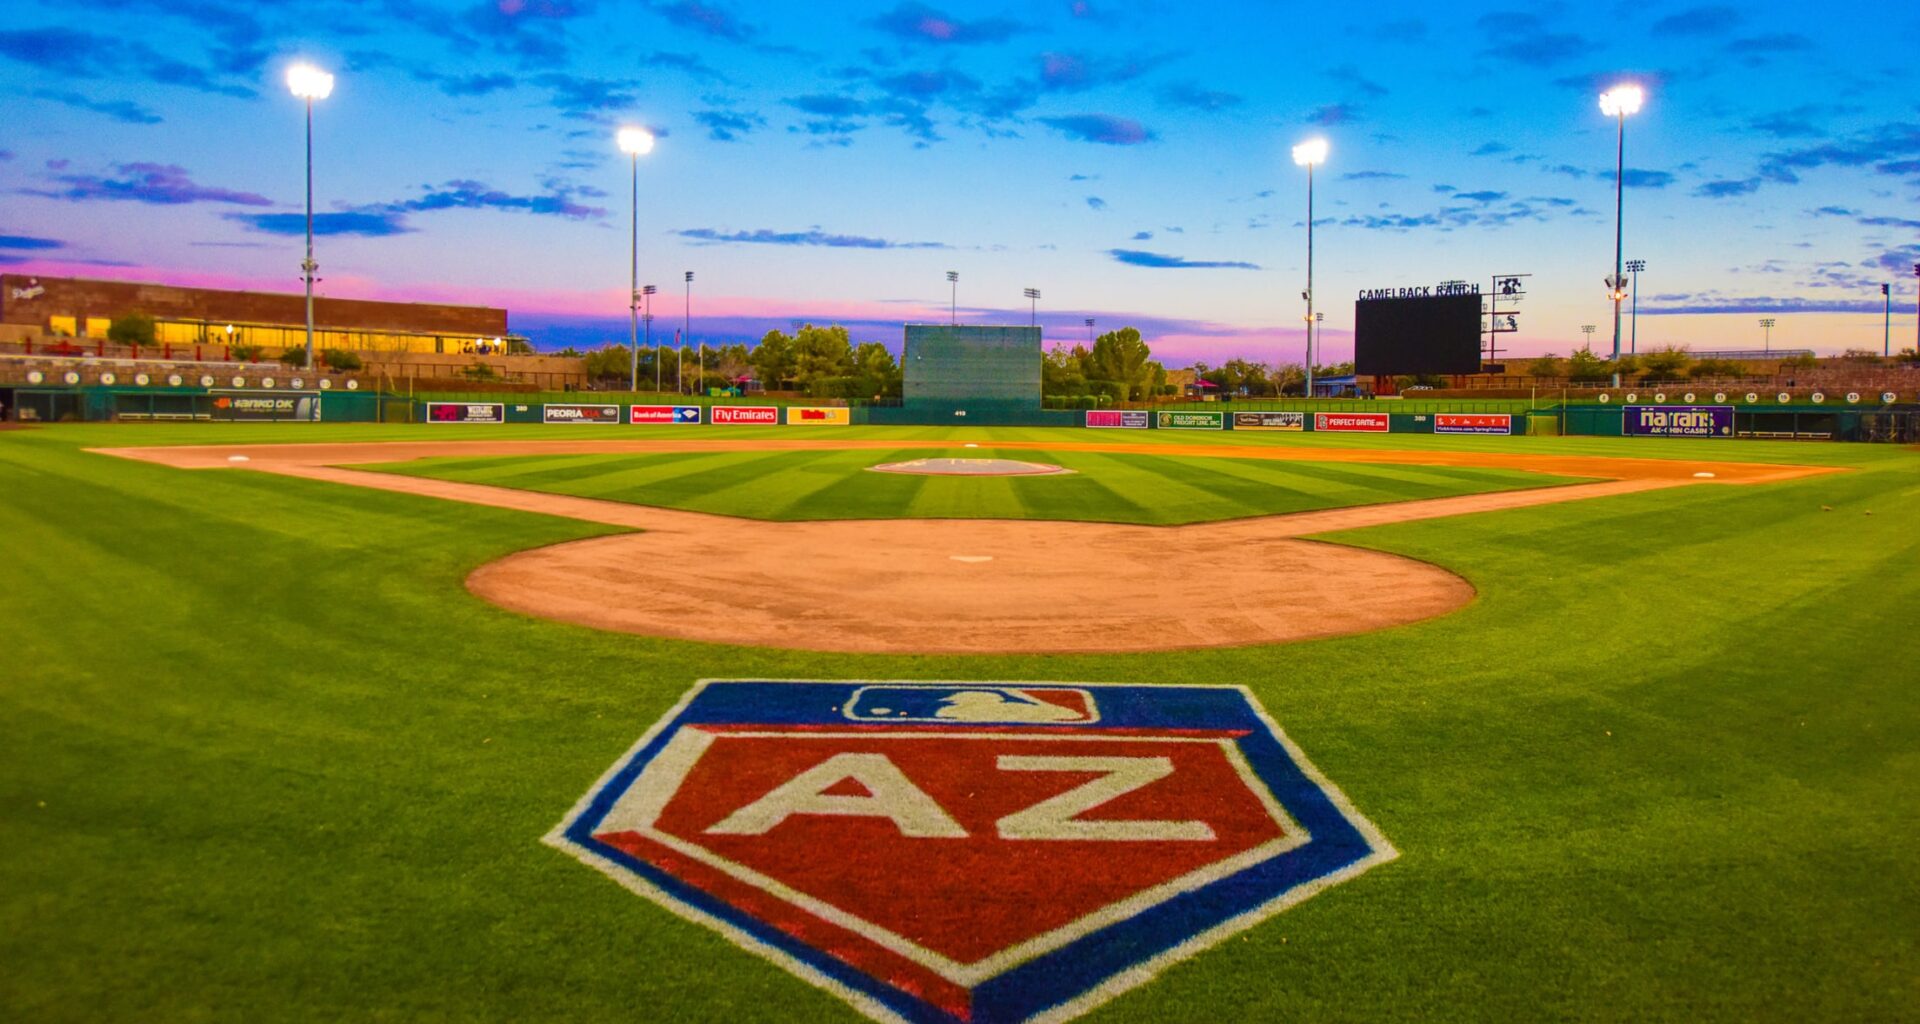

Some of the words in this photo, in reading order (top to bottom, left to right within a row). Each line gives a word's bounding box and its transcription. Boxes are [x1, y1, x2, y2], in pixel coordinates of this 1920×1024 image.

[1359, 286, 1429, 300] CAMELBACK
[1436, 283, 1479, 296] RANCH
[547, 409, 583, 418] PEORIA
[583, 410, 600, 418] KIA
[715, 409, 731, 421] Fly
[733, 409, 775, 420] Emirates
[1329, 418, 1355, 426] PERFECT
[701, 752, 1217, 841] AZ
